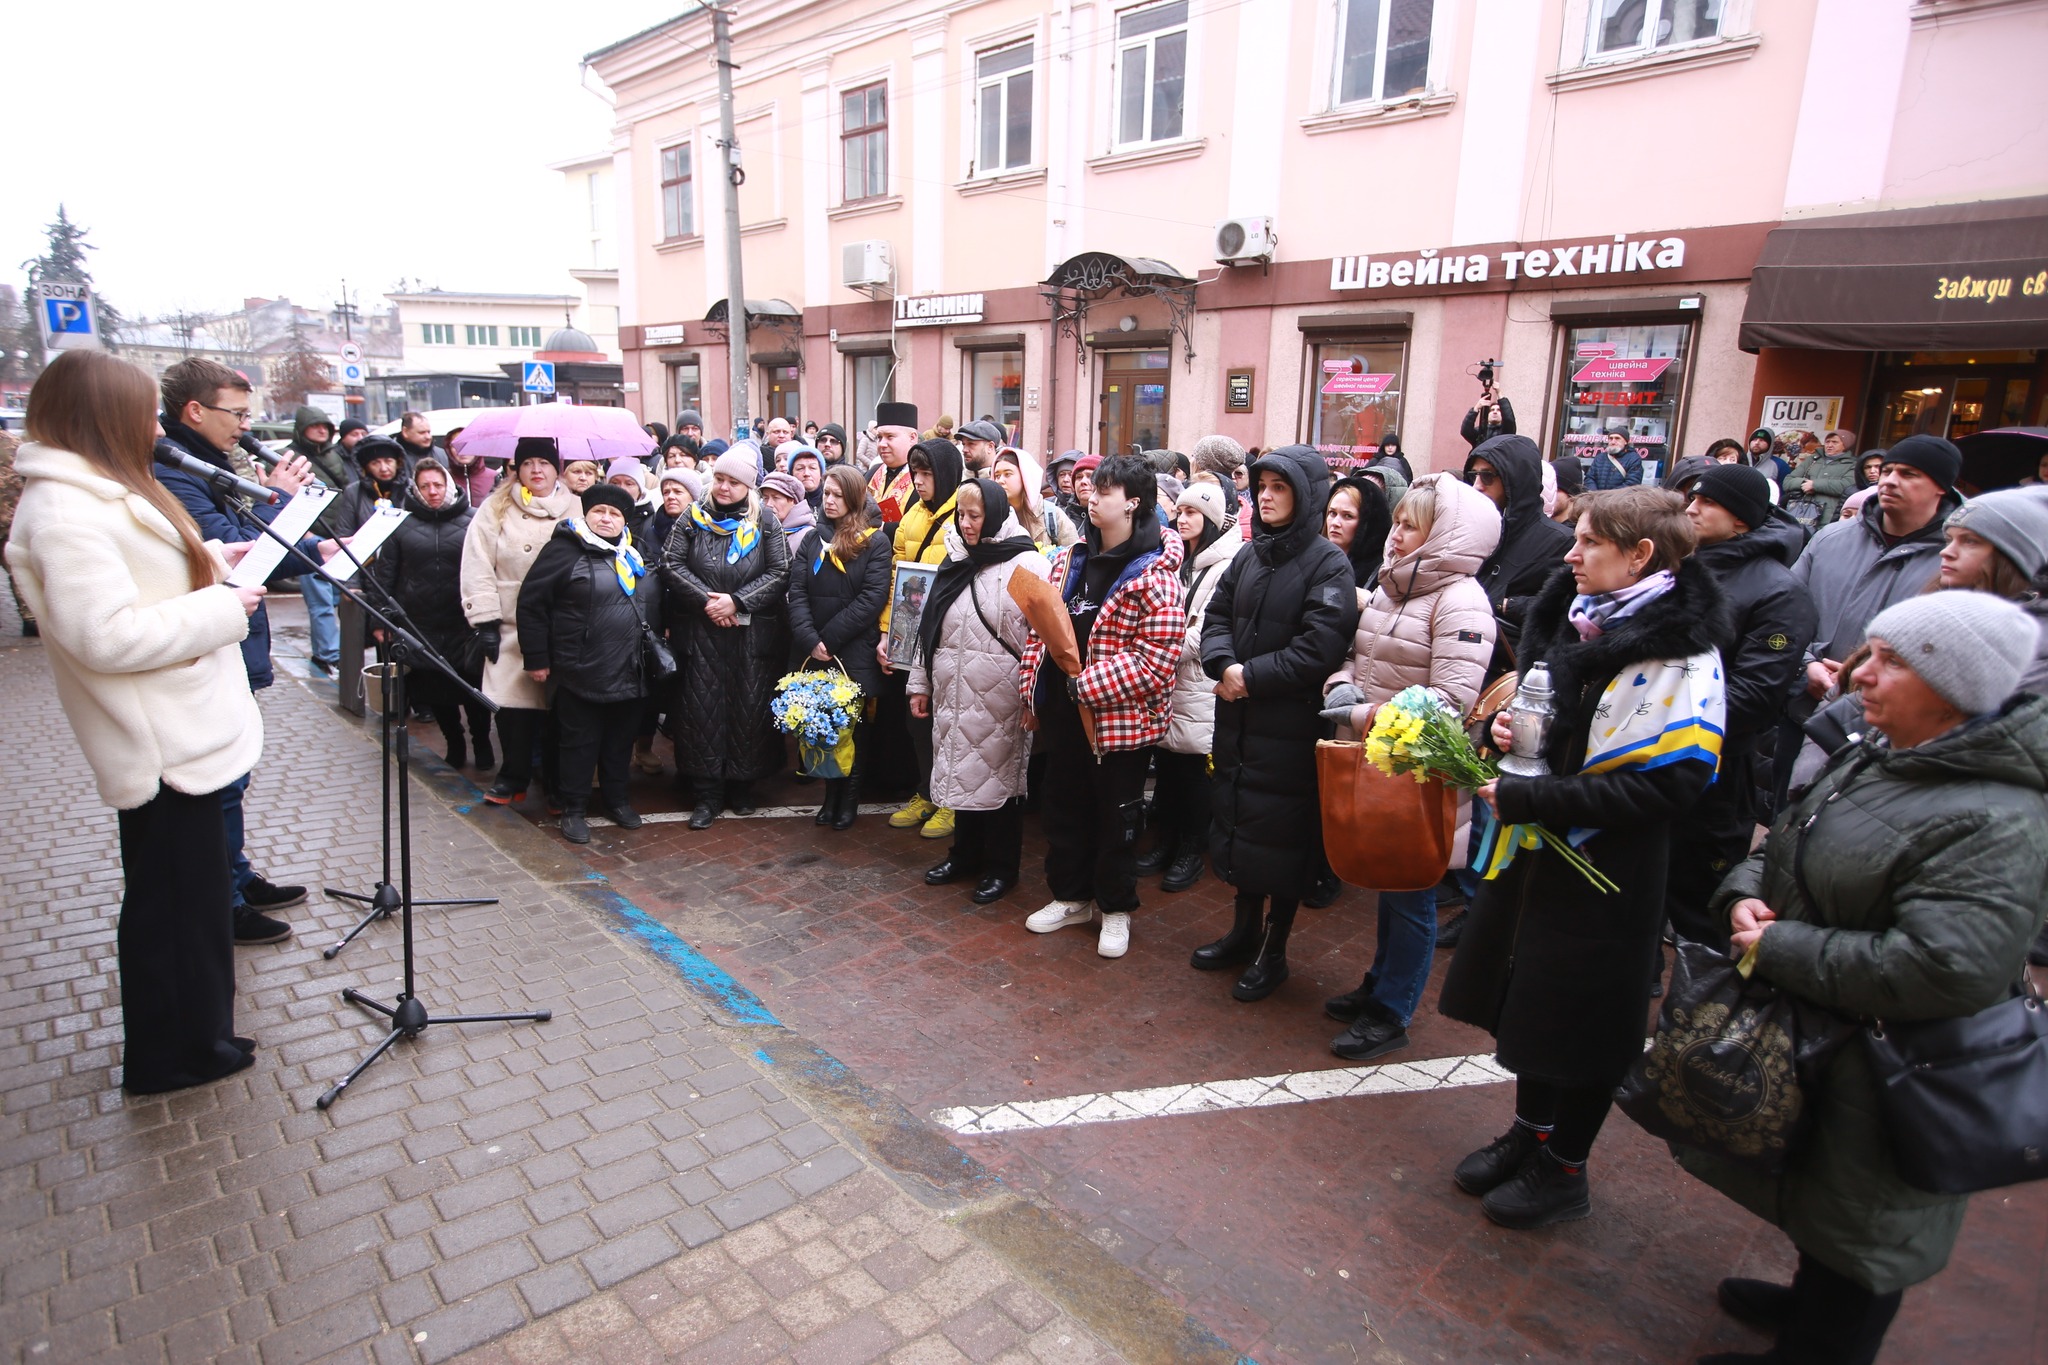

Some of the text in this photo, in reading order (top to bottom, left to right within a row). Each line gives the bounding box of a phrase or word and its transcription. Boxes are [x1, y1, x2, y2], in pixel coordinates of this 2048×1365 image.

[1330, 234, 1686, 291] Швейна техніка
[42, 284, 89, 299] ЗОНА
[1934, 271, 2048, 304] Завжди св
[895, 293, 984, 318] Тканини
[1590, 369, 1626, 378] техніка
[1608, 361, 1648, 370] швейна
[1578, 391, 1658, 406] КРЕДИТ
[1772, 400, 1818, 421] CUP
